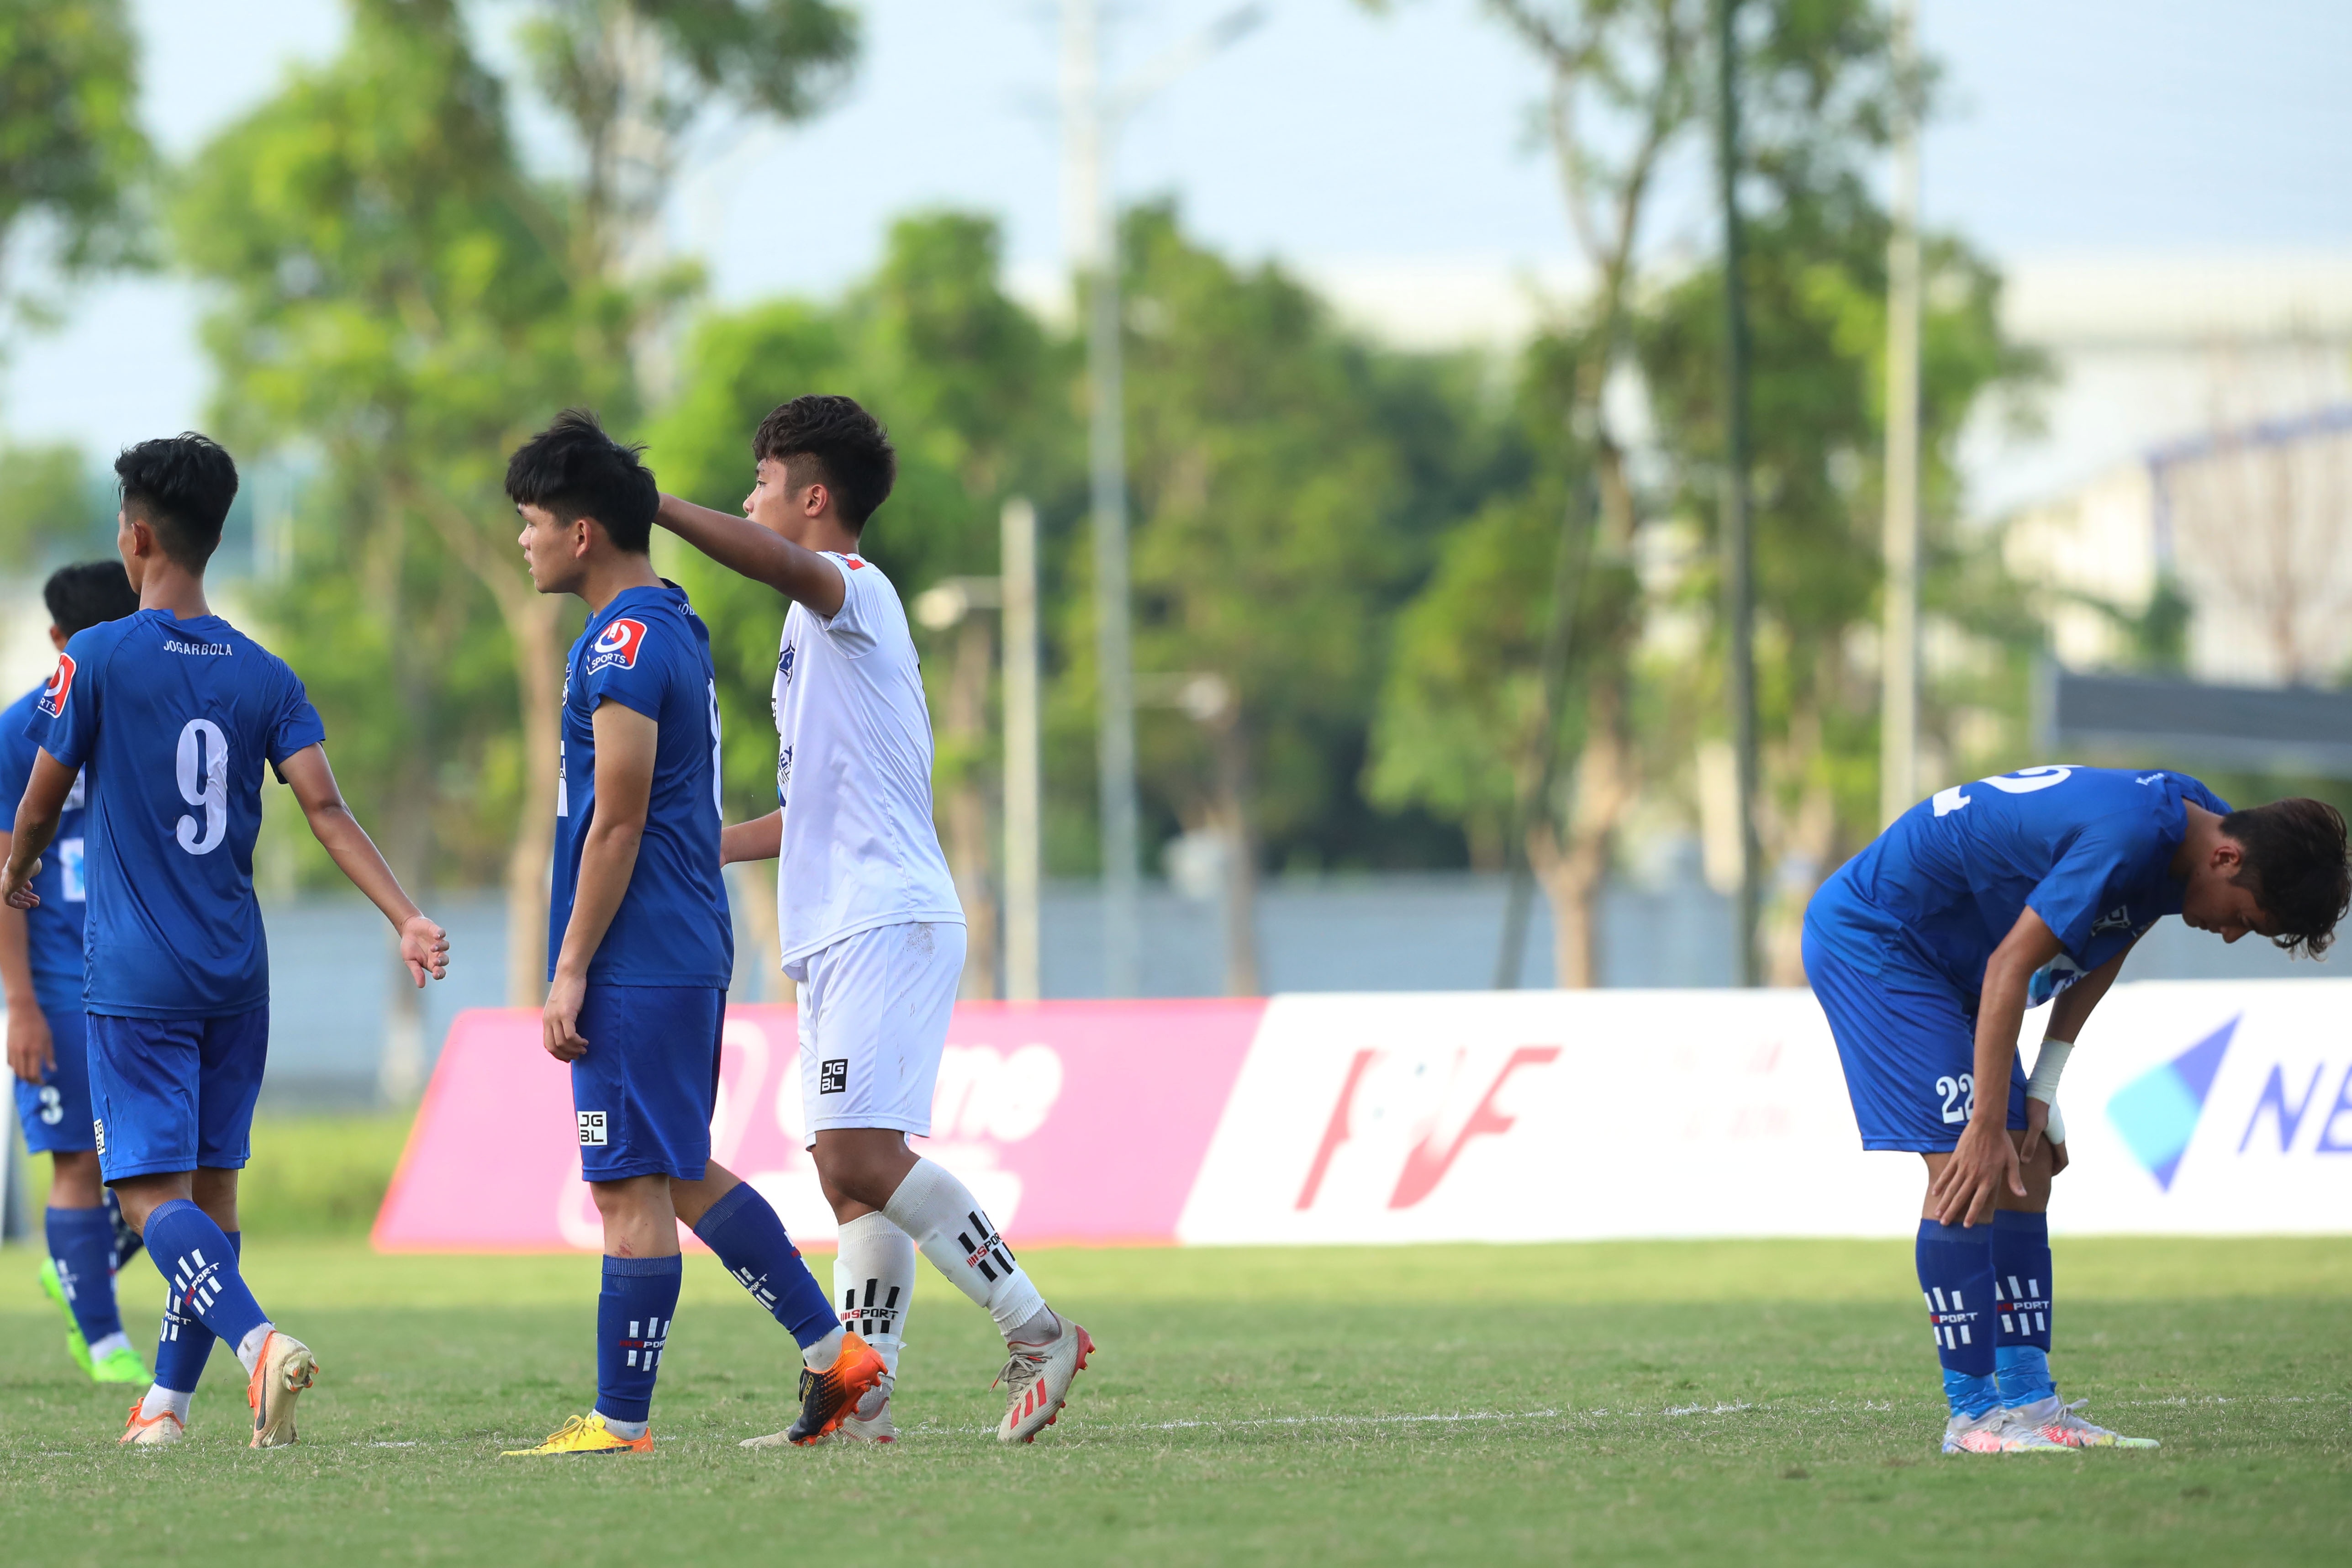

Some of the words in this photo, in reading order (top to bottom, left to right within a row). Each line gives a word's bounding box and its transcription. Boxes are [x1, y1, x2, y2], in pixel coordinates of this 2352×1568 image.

[163, 640, 232, 656] JOGARBOLA
[591, 653, 626, 668] SPORTS
[176, 718, 228, 855] 9
[823, 1062, 845, 1077] JG
[822, 1077, 843, 1092] BL
[39, 1086, 63, 1125] 3
[1936, 1073, 1975, 1124] 22
[580, 1114, 603, 1127] JG
[580, 1130, 604, 1142] BL
